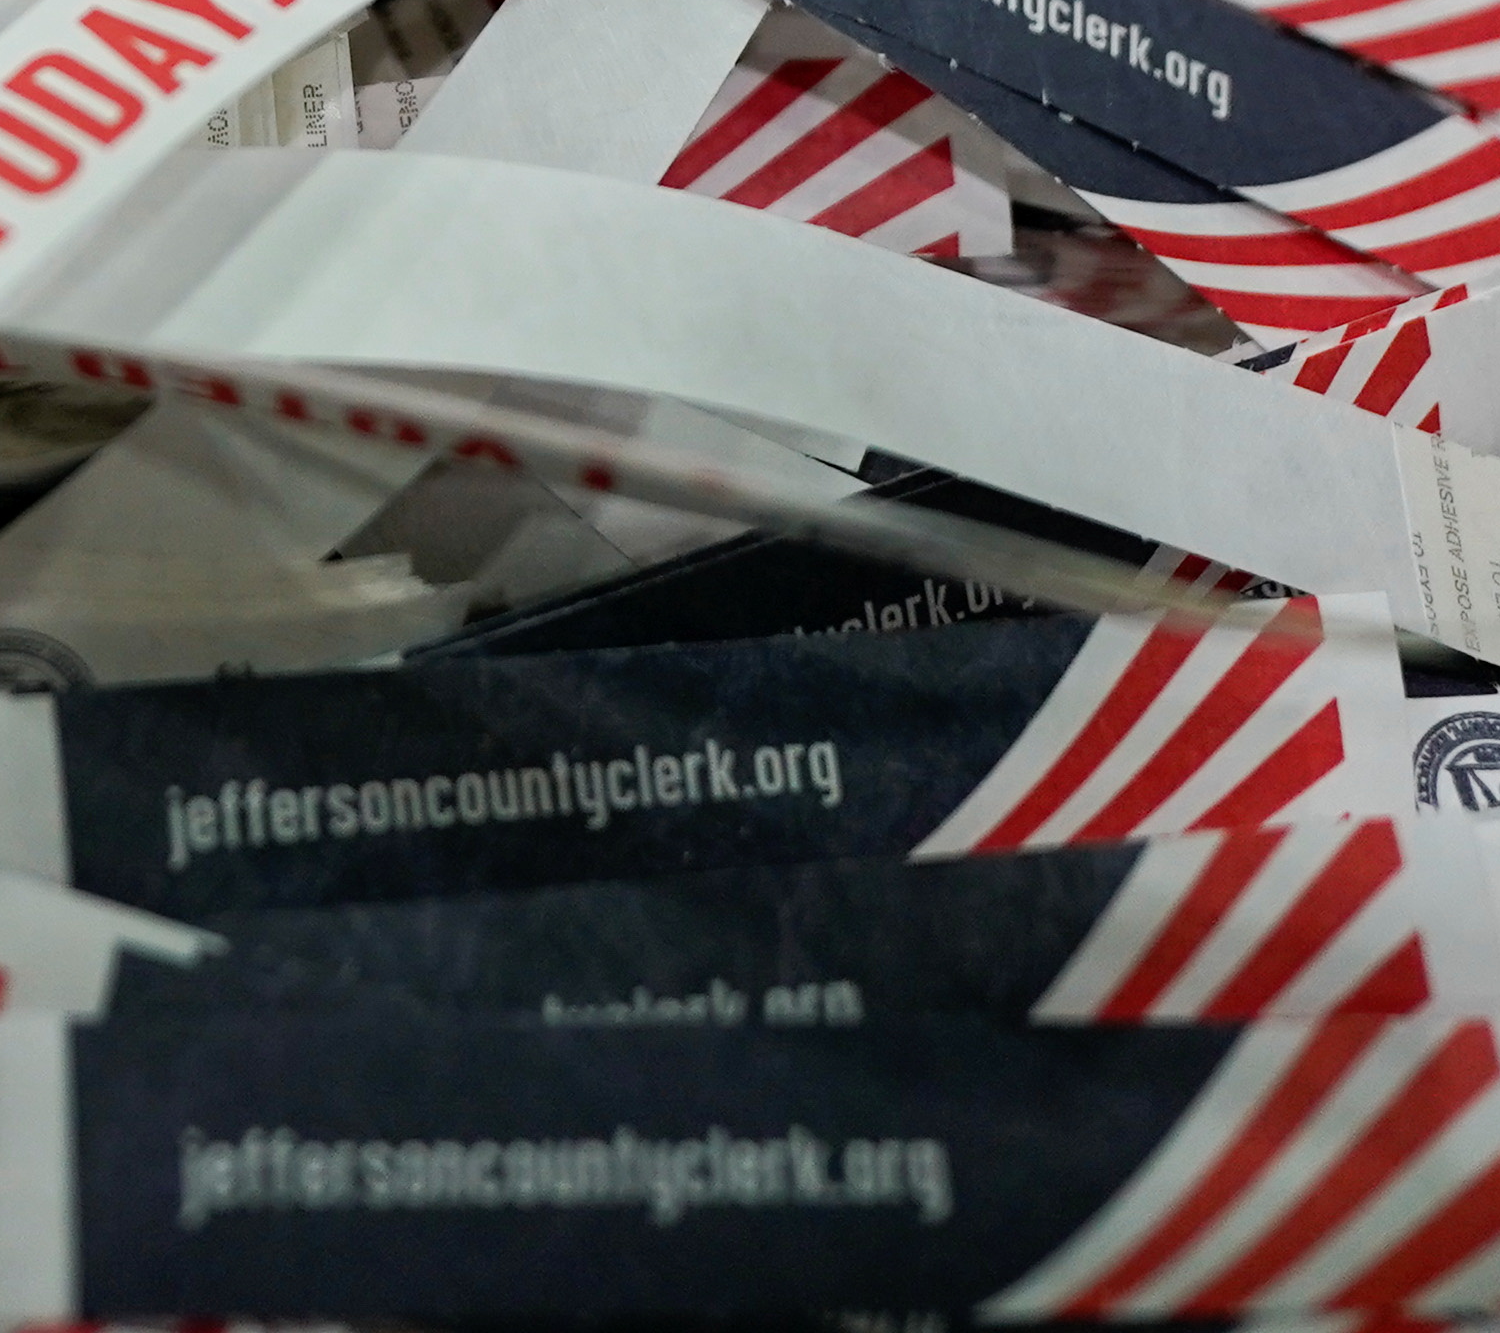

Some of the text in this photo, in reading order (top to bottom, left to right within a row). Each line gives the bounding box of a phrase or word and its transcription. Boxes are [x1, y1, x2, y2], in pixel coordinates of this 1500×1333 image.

[303, 83, 327, 148] LINER
[1434, 455, 1465, 563] ADHESIVE
[164, 738, 842, 868] jeffersoncountyclerk.org
[179, 1128, 952, 1229] jeffersoncountyclerk.org
